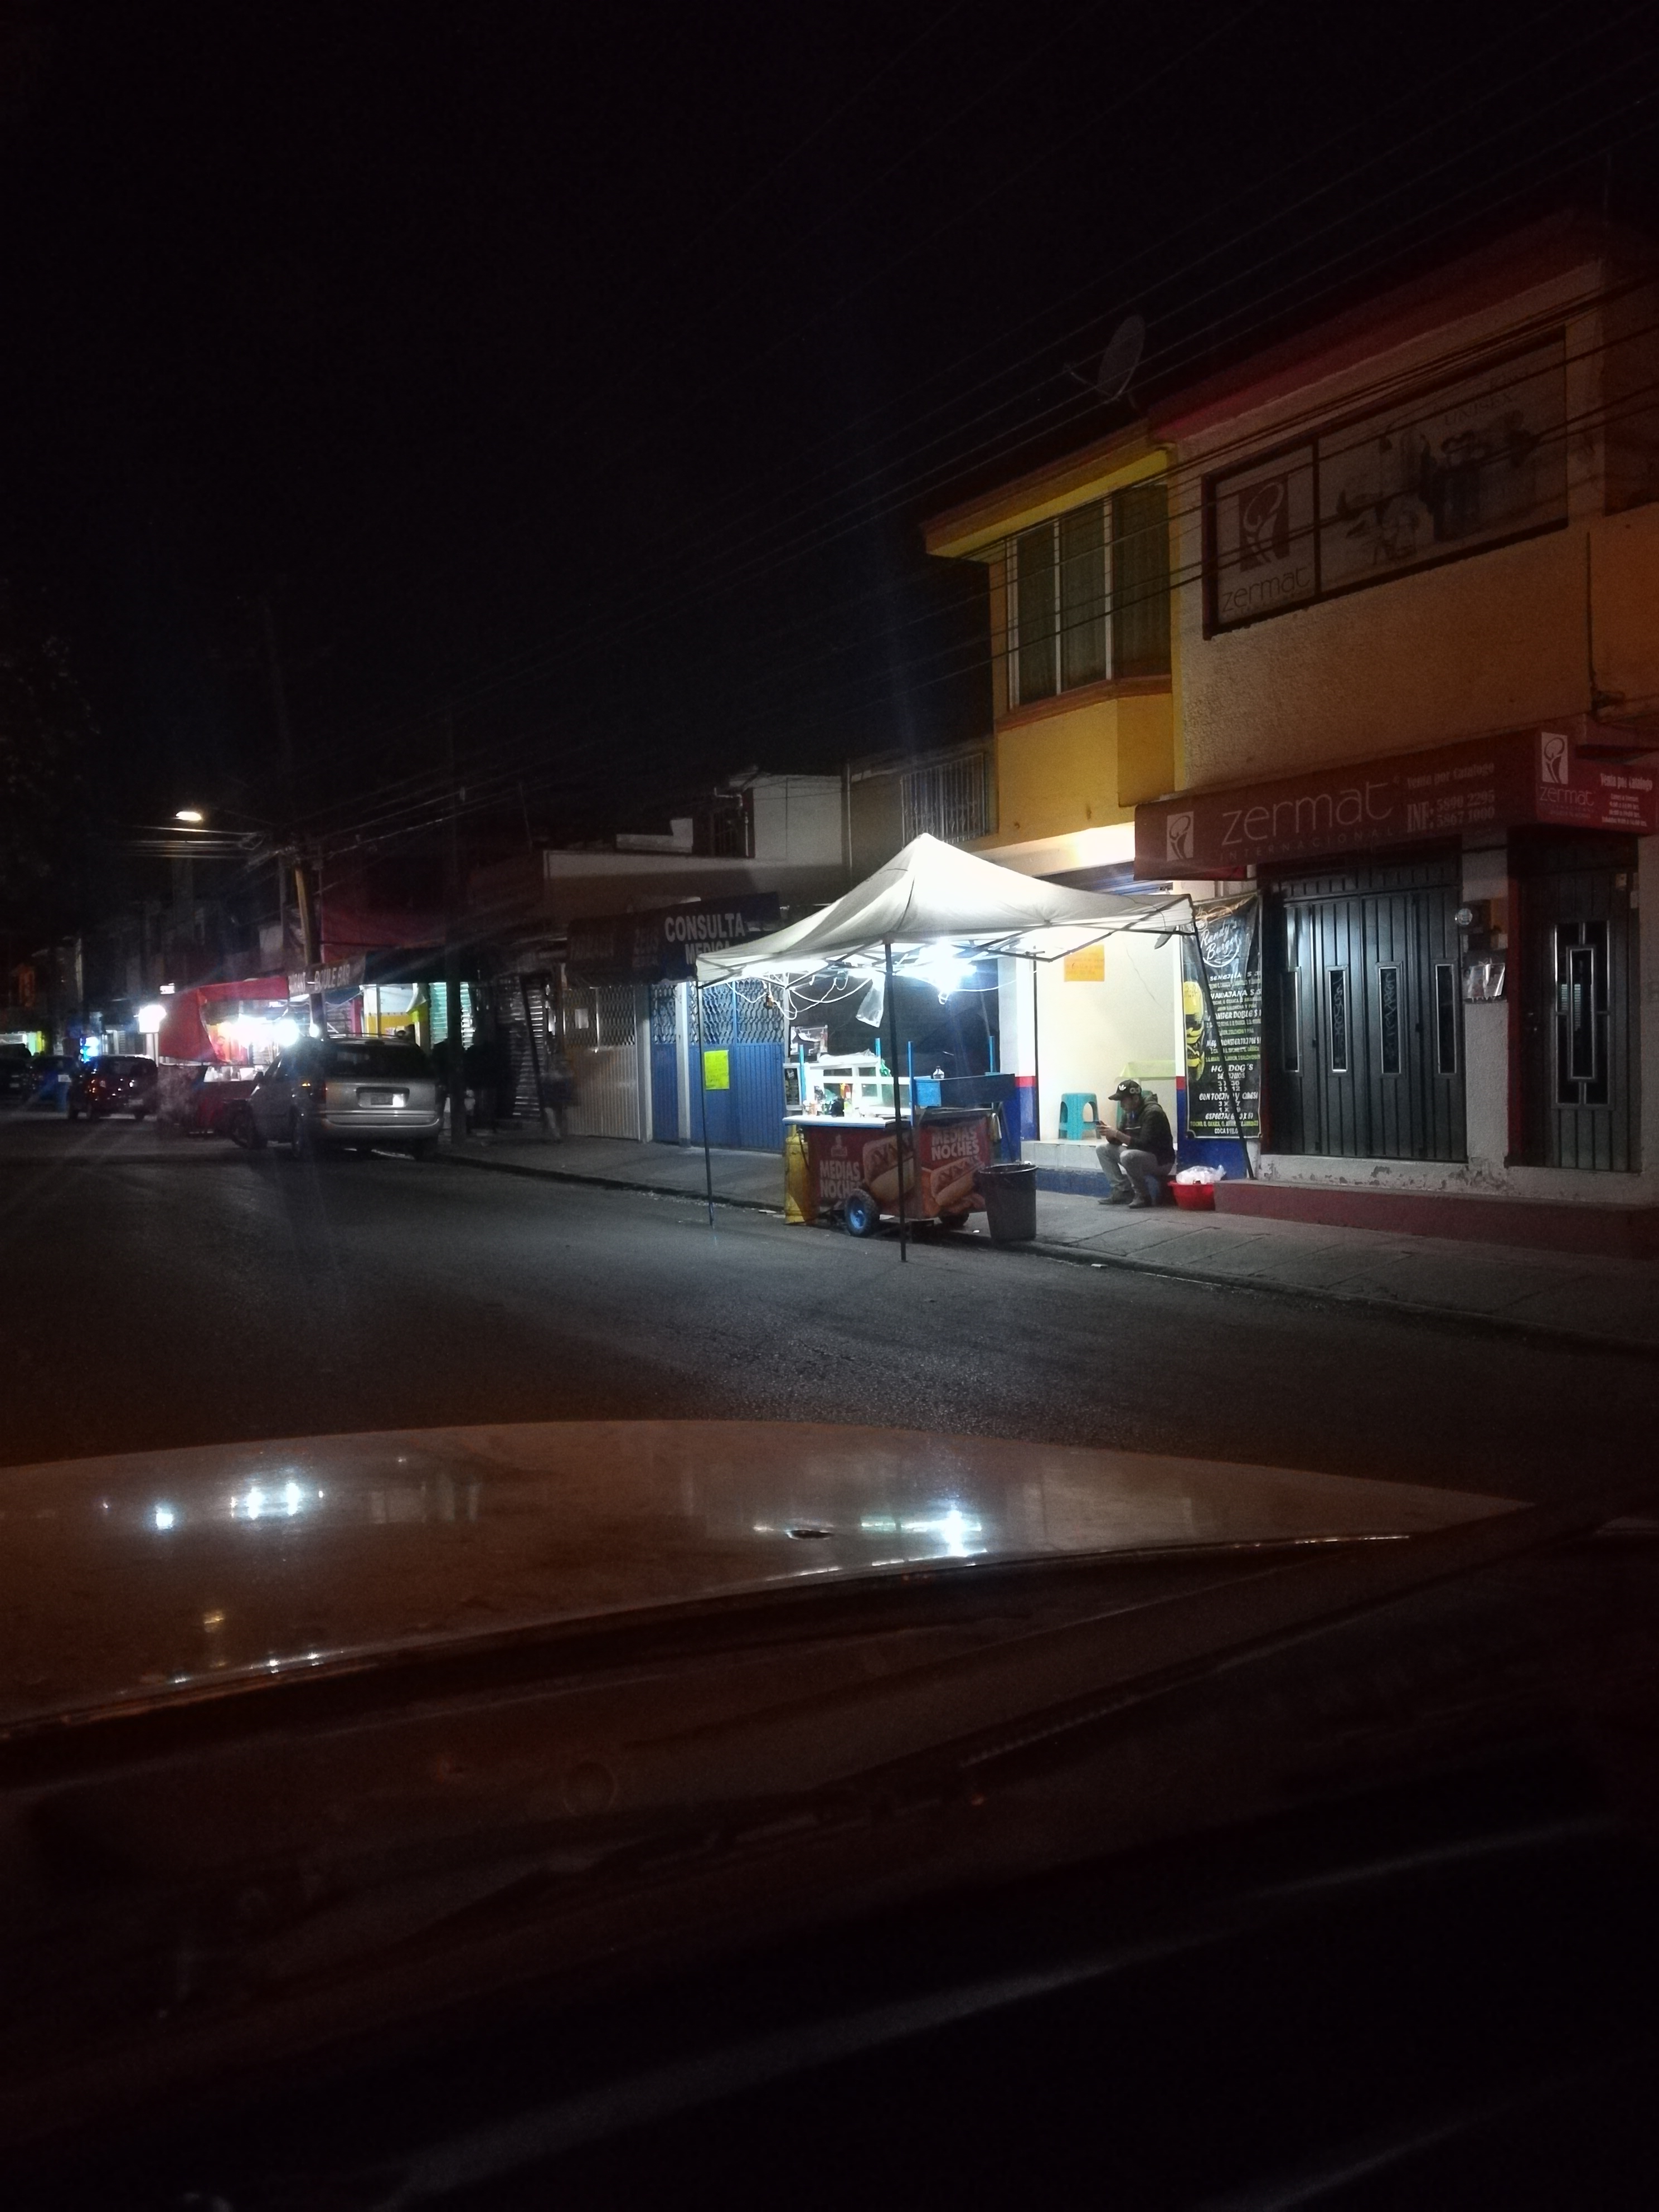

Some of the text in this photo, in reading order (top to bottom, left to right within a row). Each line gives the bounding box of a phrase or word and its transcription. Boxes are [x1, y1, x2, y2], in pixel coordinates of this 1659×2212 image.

[1222, 566, 1311, 613] zermat
[1434, 771, 1451, 785] por
[1539, 786, 1595, 807] zermat
[1221, 782, 1394, 846] zermat
[1468, 806, 1495, 823] 1000
[1219, 826, 1394, 861] INTERNACIONAL
[664, 912, 746, 943] CONSULTA
[1233, 1010, 1253, 1020] DOBLE
[932, 1126, 977, 1144] MEDIAS
[931, 1141, 980, 1161] NOCHES
[819, 1160, 861, 1181] MEDIAS
